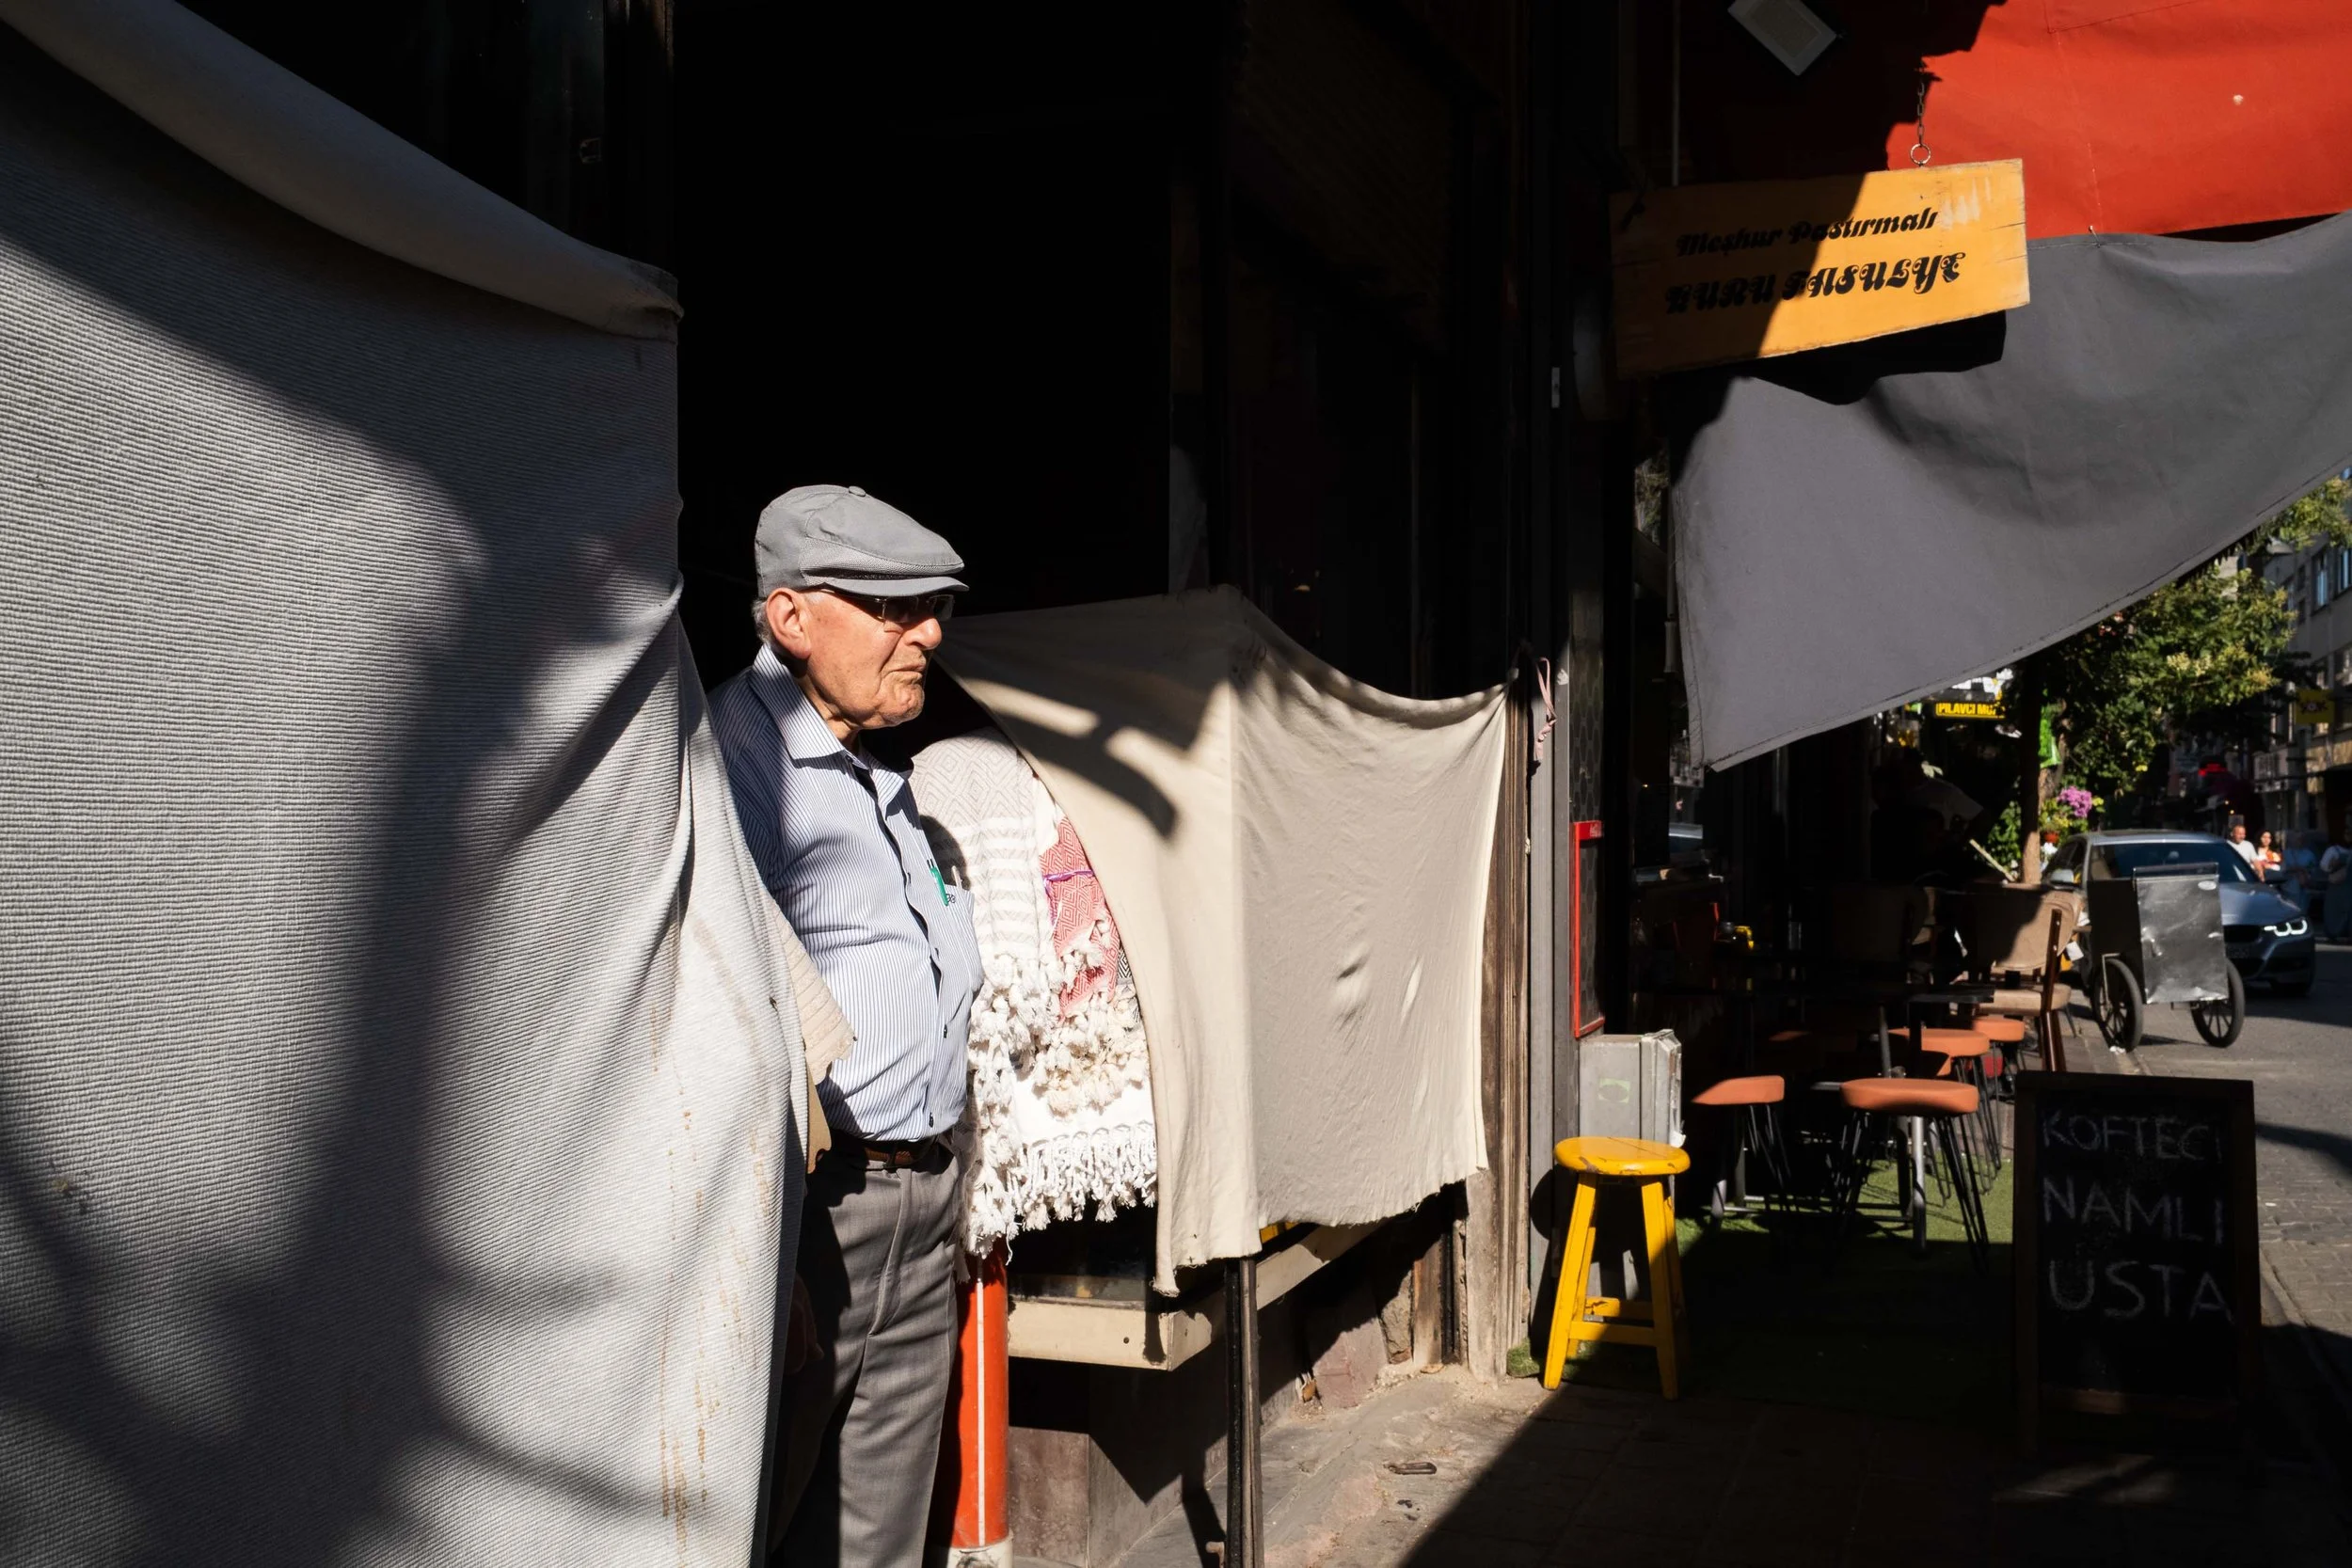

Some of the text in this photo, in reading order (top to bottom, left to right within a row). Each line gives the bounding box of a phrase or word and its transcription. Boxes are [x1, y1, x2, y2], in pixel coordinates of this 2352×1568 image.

[1677, 208, 1938, 257] Meşhur Pastırmalı
[1666, 253, 1965, 313] KURU FASULYE
[2043, 1176, 2225, 1246] NAMLI
[2049, 1258, 2235, 1324] USTA
